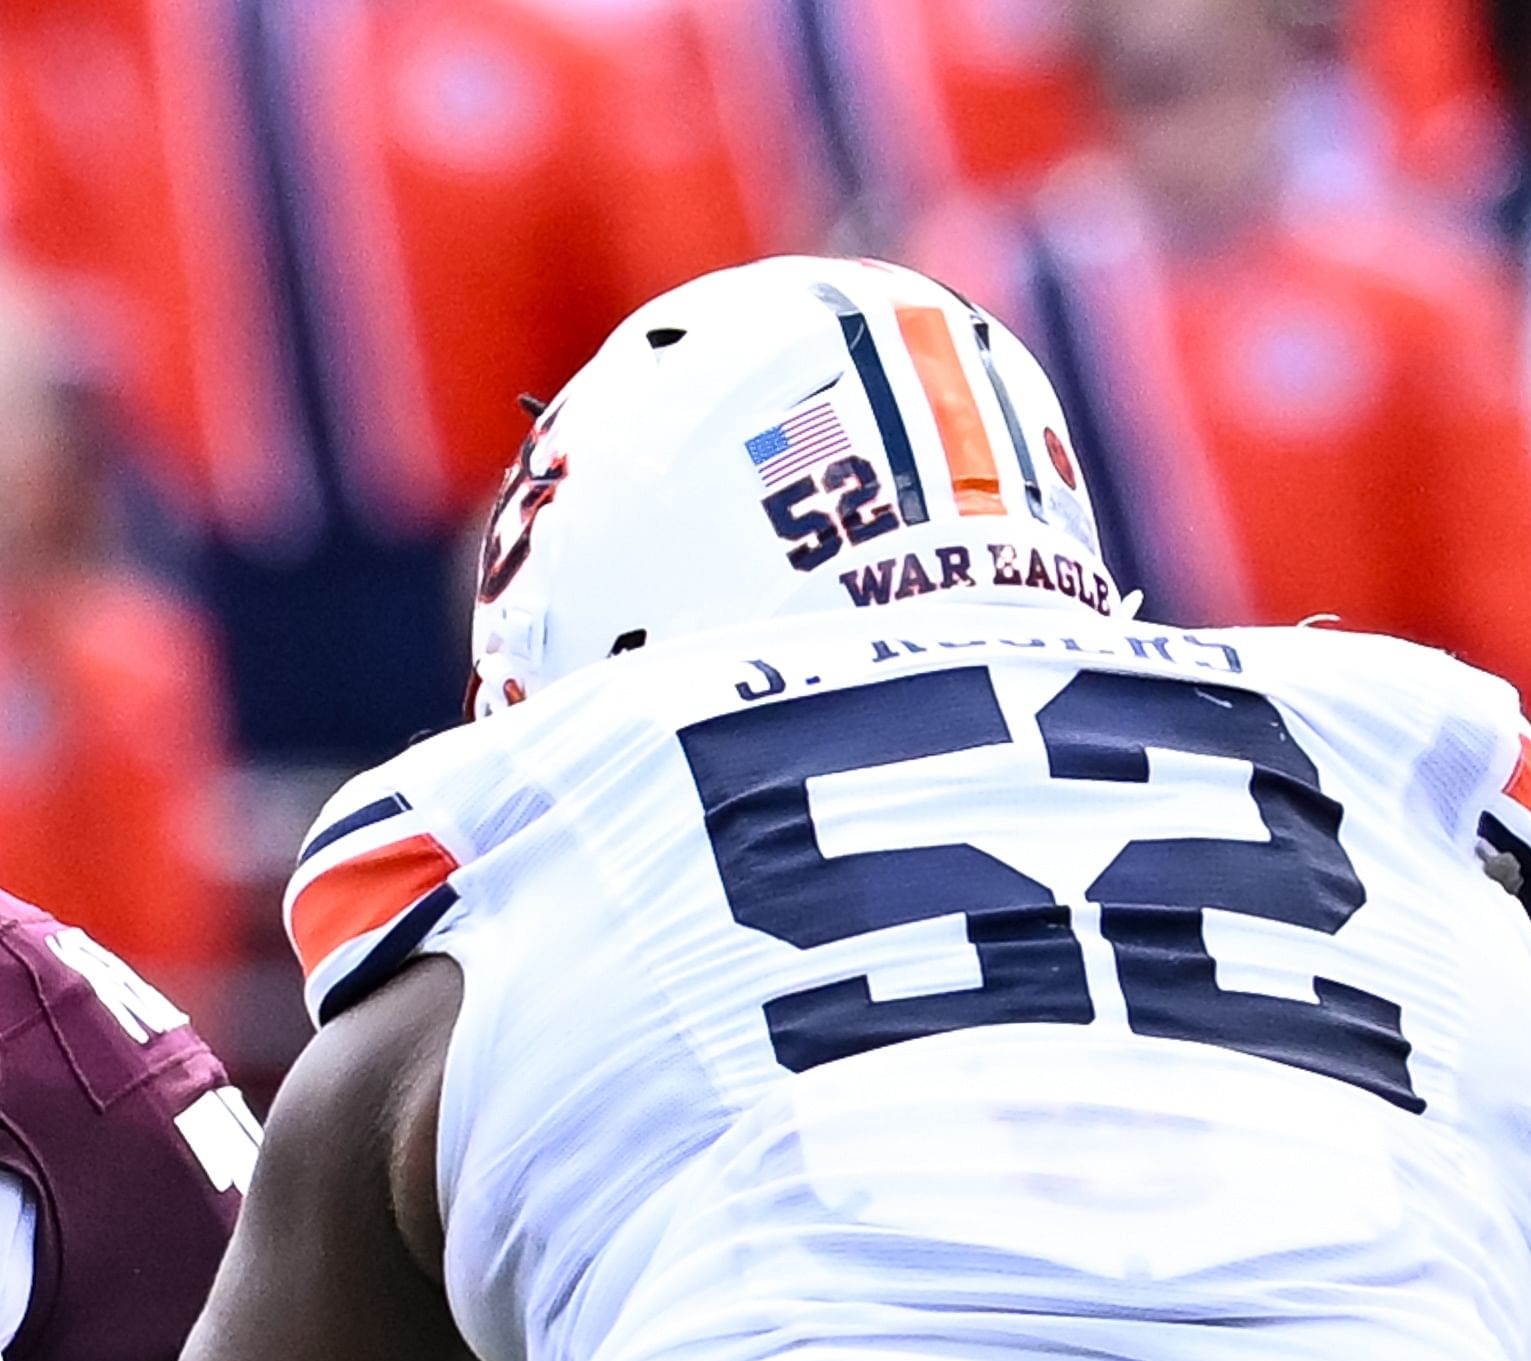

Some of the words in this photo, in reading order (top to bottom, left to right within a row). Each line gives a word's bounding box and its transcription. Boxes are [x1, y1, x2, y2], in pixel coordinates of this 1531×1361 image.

[761, 455, 900, 571] 52
[839, 546, 976, 607] WAR
[986, 544, 1111, 616] EAGLE
[680, 666, 1426, 1112] 52
